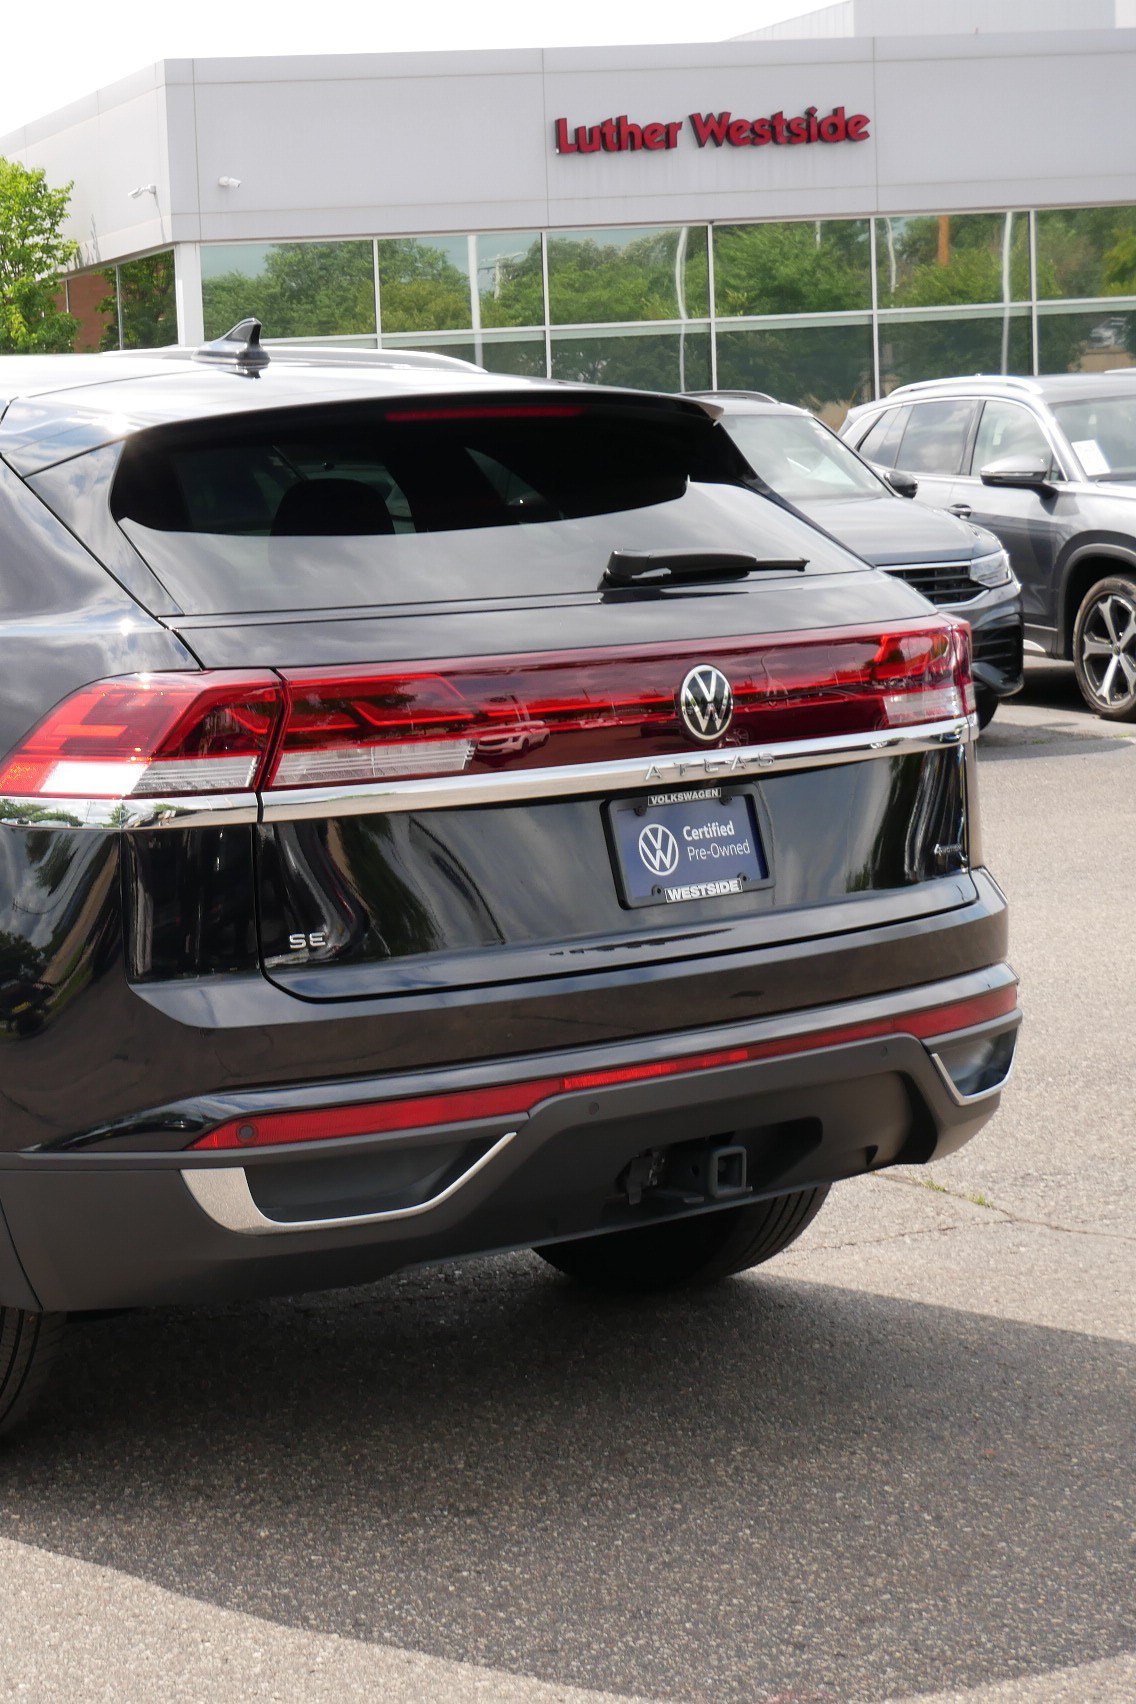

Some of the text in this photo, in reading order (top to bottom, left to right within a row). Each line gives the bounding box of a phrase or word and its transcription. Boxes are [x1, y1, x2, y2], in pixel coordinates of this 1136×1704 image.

[554, 106, 871, 154] Luther Westside
[645, 752, 774, 780] ATLAS
[651, 789, 719, 805] VOLKSWAGEN
[683, 820, 735, 841] Certified
[687, 839, 750, 861] Pre-Owned
[667, 879, 740, 901] WESTSIDE
[289, 932, 326, 949] SE
